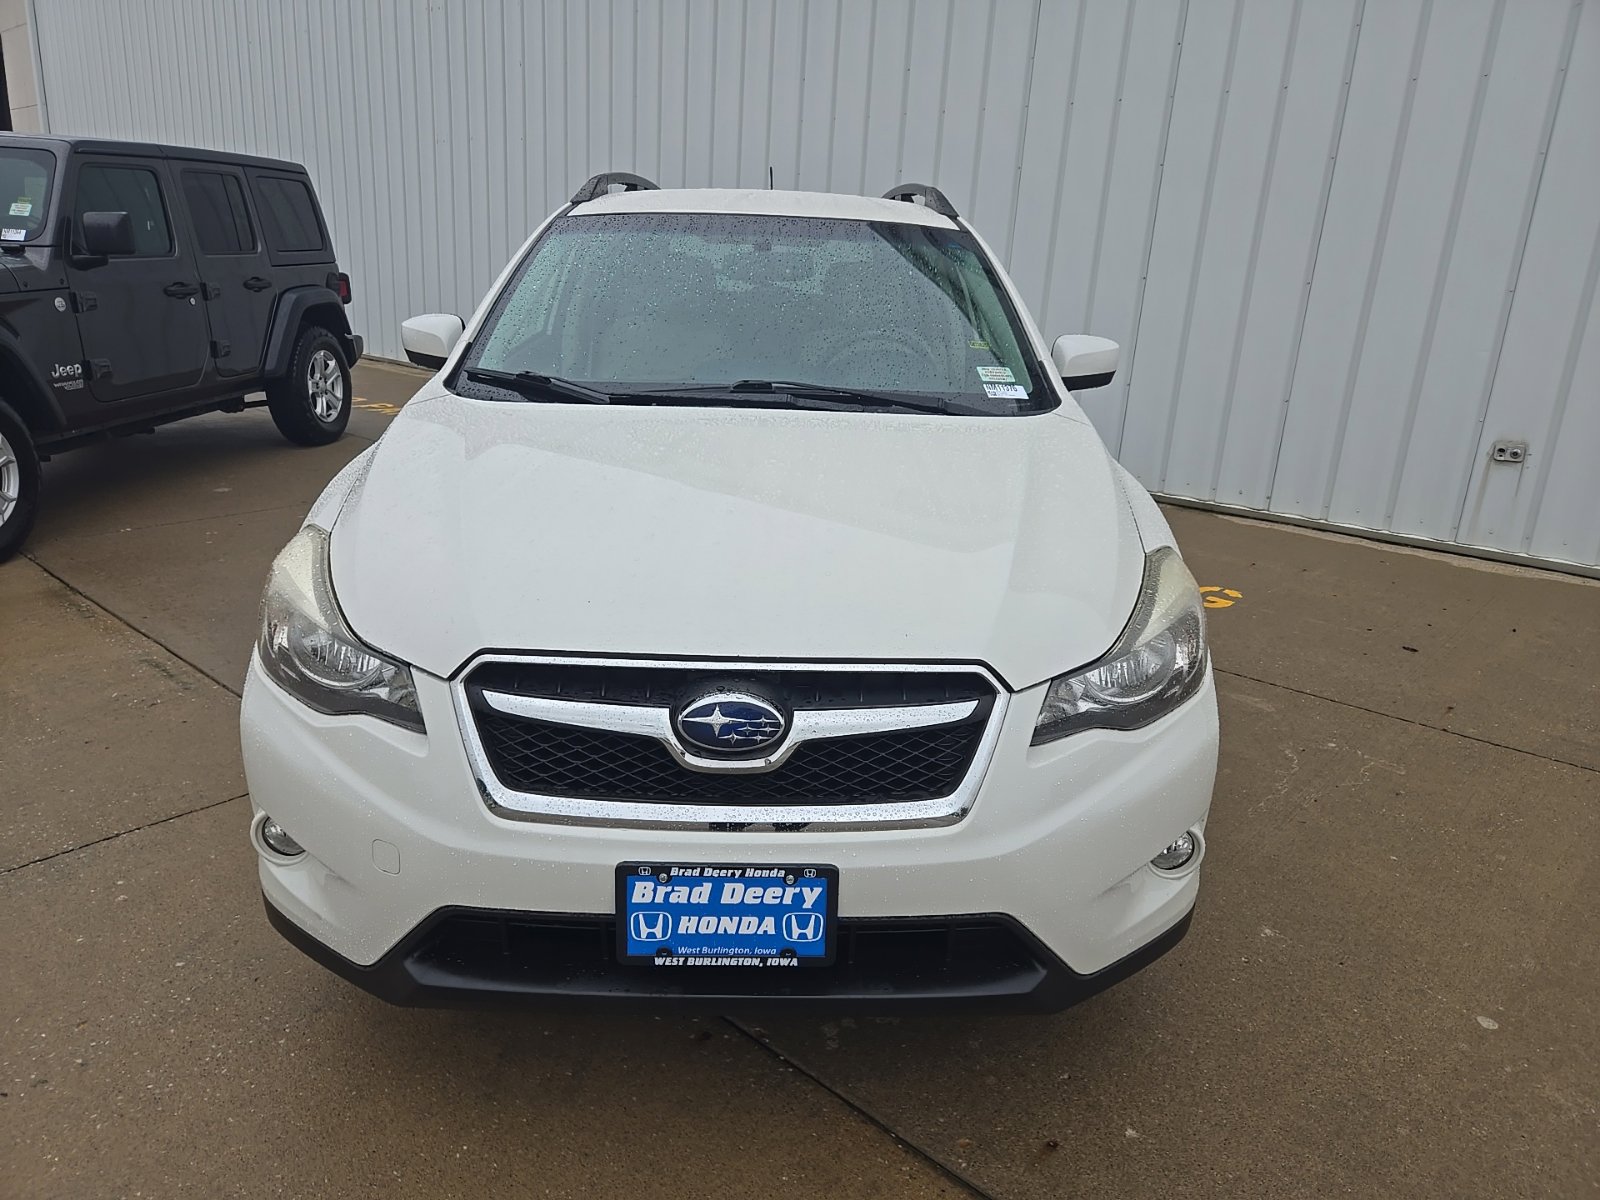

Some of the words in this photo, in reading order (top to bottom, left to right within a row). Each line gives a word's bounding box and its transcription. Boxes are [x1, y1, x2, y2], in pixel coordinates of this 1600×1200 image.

[51, 363, 82, 378] Jeep
[670, 867, 700, 877] Brad
[704, 868, 742, 878] Deery
[745, 868, 785, 877] Honda
[631, 881, 713, 904] Brad
[720, 882, 823, 909] Deery
[677, 916, 776, 935] HONDA
[677, 946, 700, 955] West
[701, 946, 753, 957] Burlington,
[654, 957, 685, 966] WEST
[686, 957, 764, 967] BURLINGTON,
[766, 957, 799, 967] IOWA
